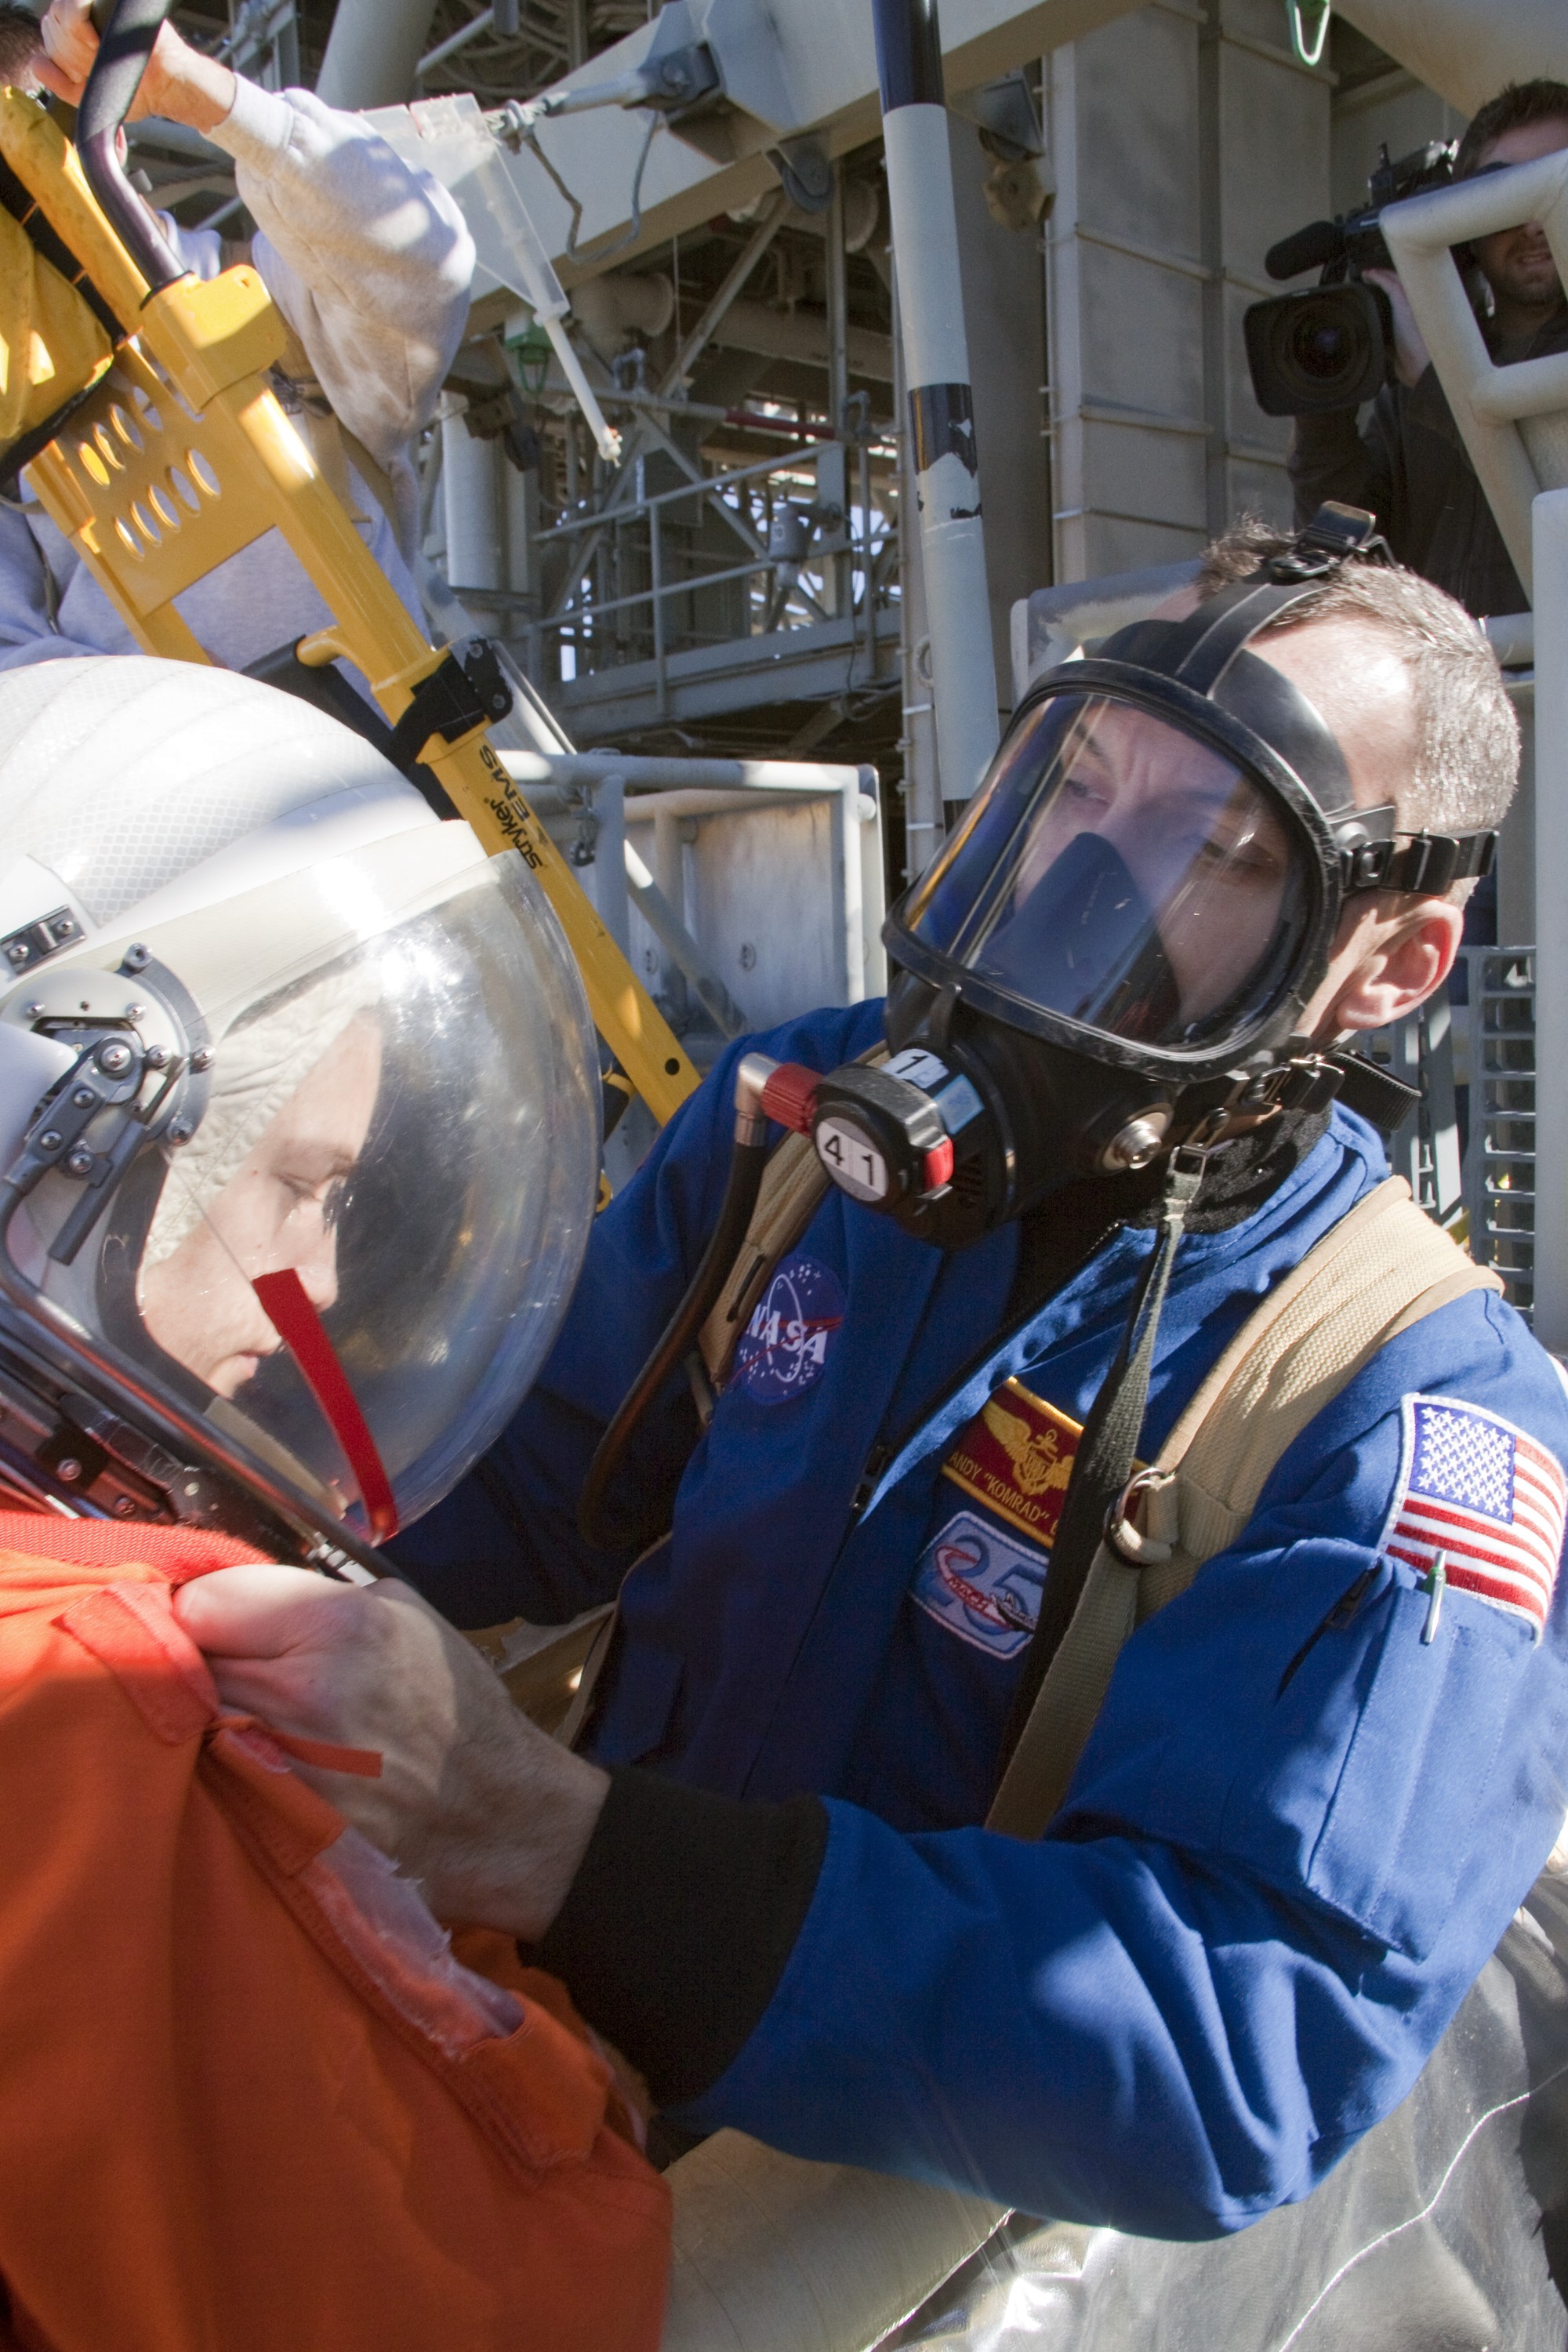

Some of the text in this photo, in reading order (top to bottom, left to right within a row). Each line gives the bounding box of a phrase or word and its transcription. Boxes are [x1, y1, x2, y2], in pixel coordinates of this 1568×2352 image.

[479, 744, 531, 822] EMS
[490, 799, 543, 869] stryker
[746, 1303, 828, 1364] NASA
